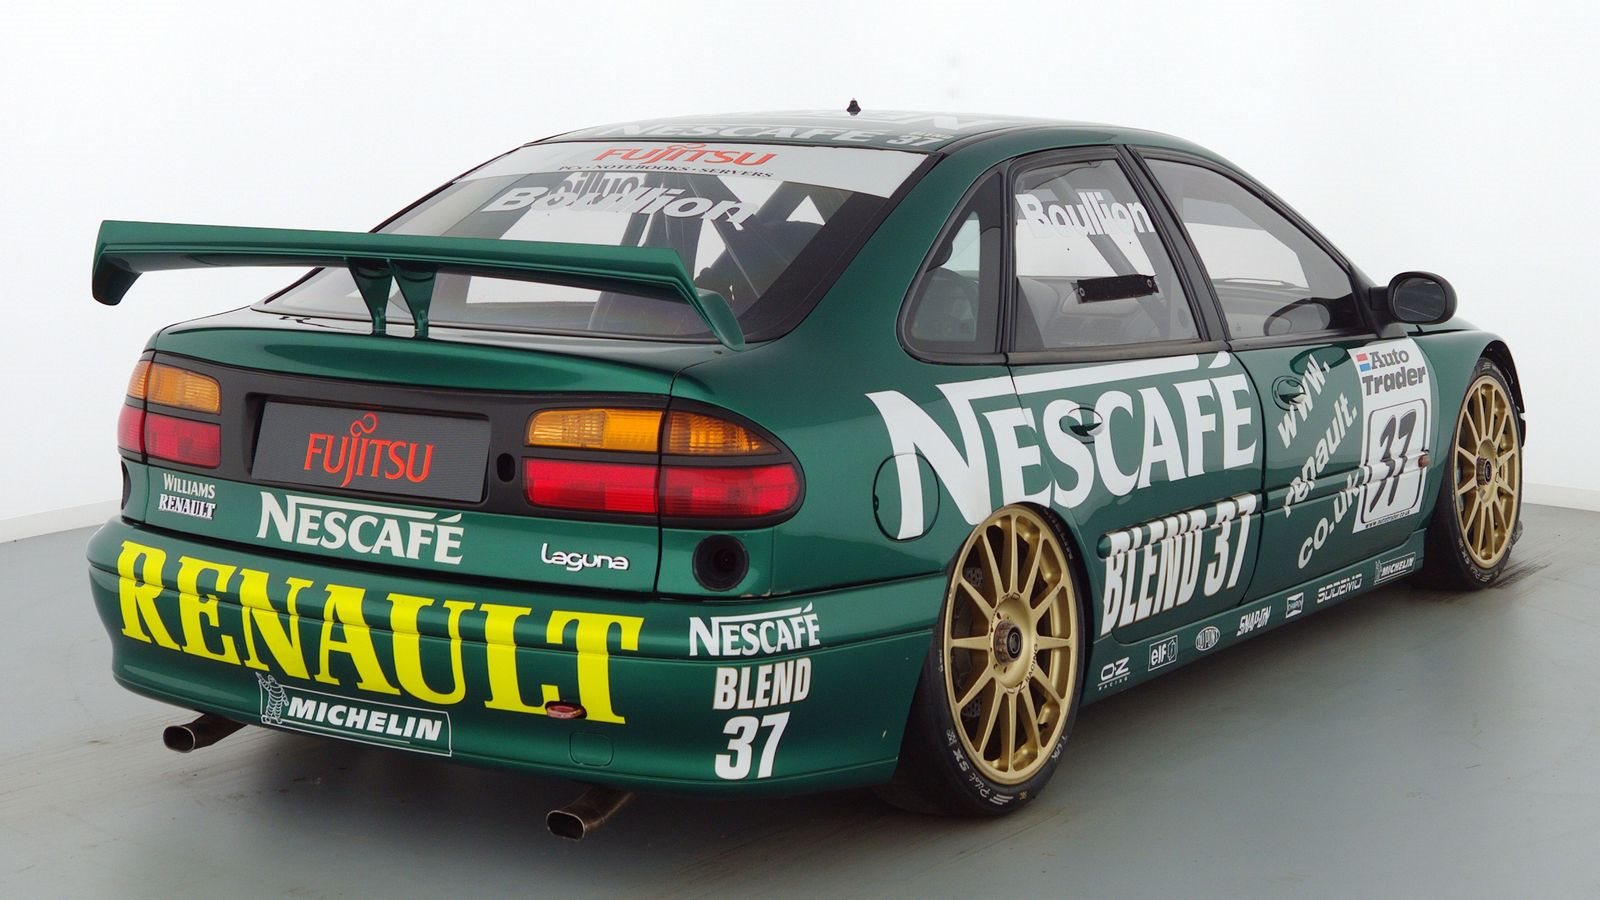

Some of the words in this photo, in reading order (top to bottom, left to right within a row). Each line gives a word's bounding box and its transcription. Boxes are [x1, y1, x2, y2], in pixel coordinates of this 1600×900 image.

[593, 147, 777, 166] FUJITSU
[596, 163, 690, 172] NOTEBOOKS
[700, 168, 775, 178] SERVERS
[481, 186, 757, 224] Boullion
[1015, 191, 1156, 237] Boullion
[1362, 365, 1427, 396] Trader
[1371, 349, 1409, 370] Auto
[1278, 353, 1330, 448] www.
[304, 432, 434, 488] FUJITSU
[865, 351, 1257, 540] NESCAFÉ
[1283, 392, 1357, 518] renault.
[158, 493, 216, 520] RENAULT
[163, 473, 216, 499] WILLIAMS
[256, 491, 464, 565] NESCAFÉ
[1298, 472, 1360, 569] co.uk
[1101, 508, 1207, 637] BLEND
[1204, 493, 1257, 597] 37
[1381, 557, 1415, 577] MICHELIN
[117, 540, 644, 725] RENAULT
[689, 602, 821, 656] NESCAFÉ
[1151, 643, 1167, 667] elf
[712, 657, 812, 710] BLEND
[287, 697, 442, 742] MICHELIN
[714, 711, 791, 781] 37
